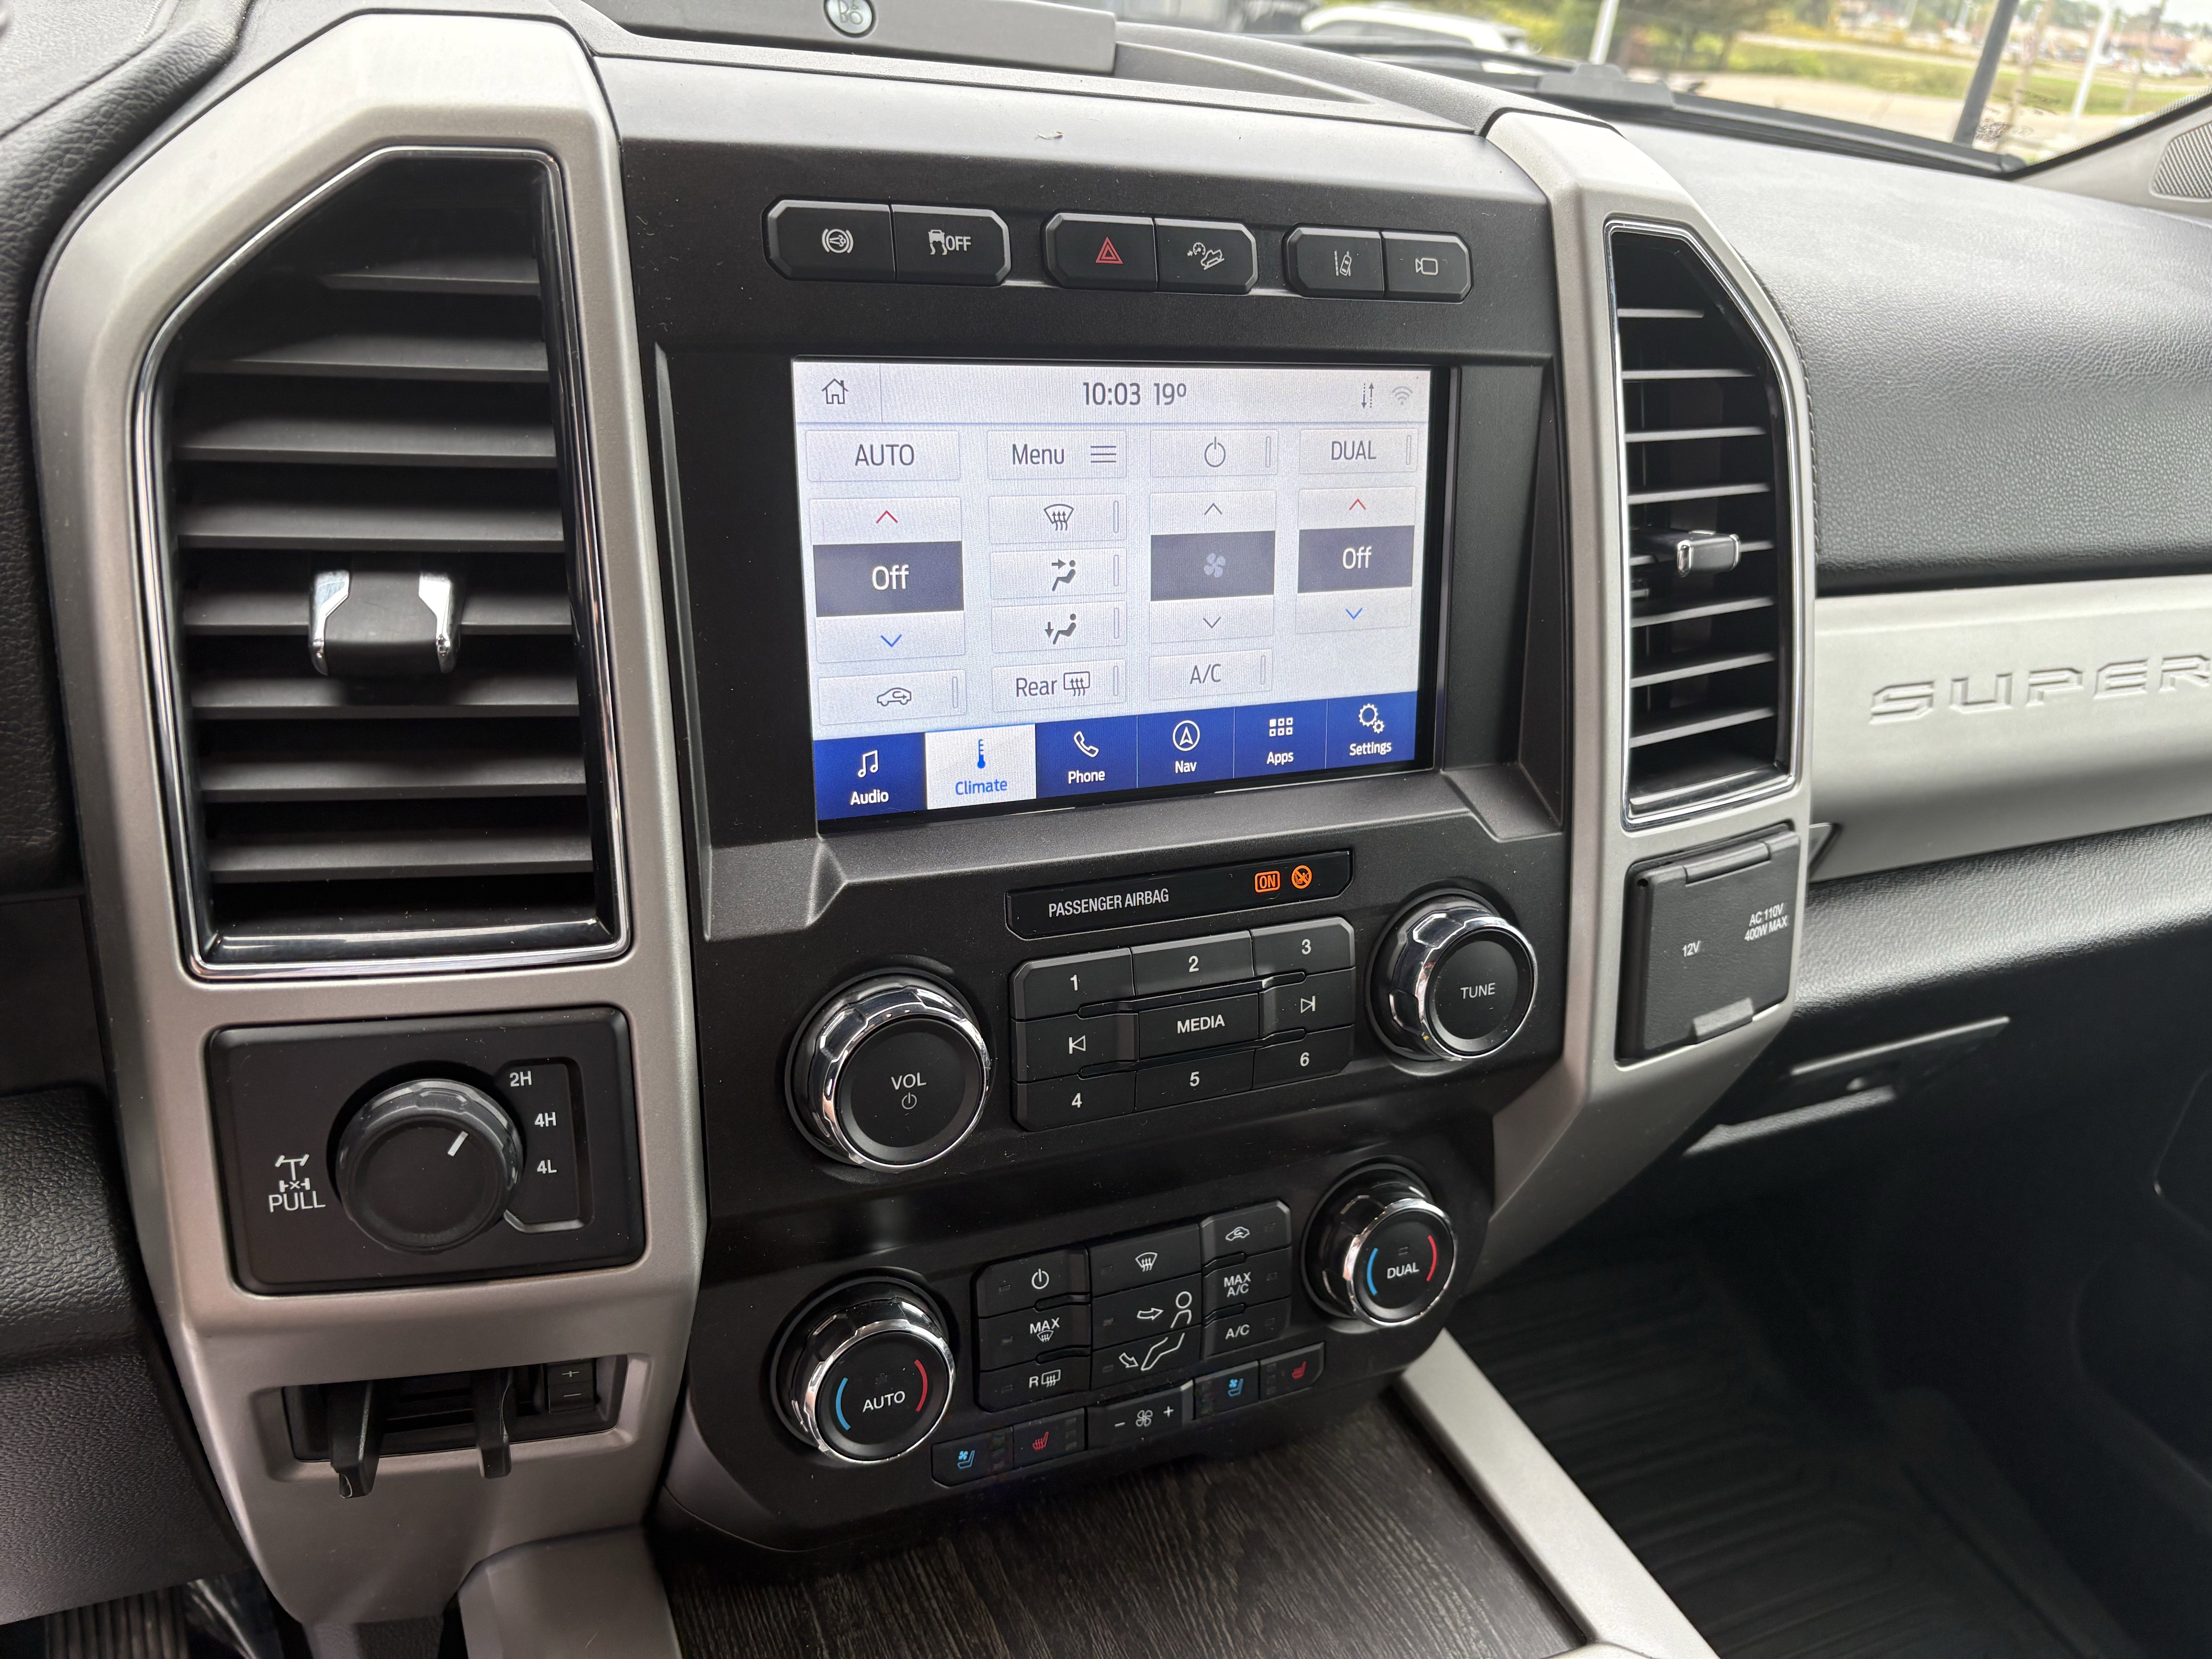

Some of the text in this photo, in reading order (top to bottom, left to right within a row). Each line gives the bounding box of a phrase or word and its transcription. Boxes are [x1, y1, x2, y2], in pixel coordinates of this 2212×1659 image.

[946, 235, 971, 251] OFF
[1083, 382, 1140, 405] 10:03
[855, 444, 914, 466] AUTO
[1012, 443, 1064, 465] Menu
[1331, 440, 1377, 460] DUAL
[1343, 546, 1372, 569] Off
[872, 564, 909, 590] Off
[1190, 663, 1221, 684] A/C
[1016, 677, 1058, 697] Rear
[1869, 654, 2210, 725] SUPER
[1349, 741, 1392, 756] Settings
[1175, 760, 1197, 773] Nav
[1266, 751, 1294, 766] Apps
[1068, 770, 1105, 784] Phone
[955, 779, 1007, 795] Climate
[850, 789, 889, 805] Audio
[1259, 874, 1275, 889] ON
[1049, 888, 1169, 917] PASSENGER AIRBAG
[1749, 902, 1784, 927] AC 110V
[1744, 914, 1788, 941] 400W MAX
[1302, 939, 1311, 955] 3
[1682, 940, 1701, 957] 12V
[1188, 955, 1199, 972] 2
[1070, 975, 1078, 991] 1
[1460, 982, 1496, 999] TUNE
[1177, 1014, 1225, 1034] MEDIA
[1300, 1052, 1309, 1066] 6
[510, 1071, 532, 1087] 2H
[891, 1072, 927, 1090] VOL
[1190, 1071, 1200, 1087] 5
[1072, 1092, 1082, 1108] 4
[534, 1112, 556, 1127] 4H
[537, 1159, 557, 1174] 4L
[268, 1191, 326, 1212] PULL
[1387, 1262, 1420, 1279] DUAL
[1224, 1272, 1251, 1287] MAX
[1226, 1283, 1249, 1298] A/C
[1030, 1317, 1060, 1334] MAX
[1225, 1324, 1250, 1340] A/C
[1029, 1376, 1039, 1388] R
[862, 1391, 905, 1412] AUTO
